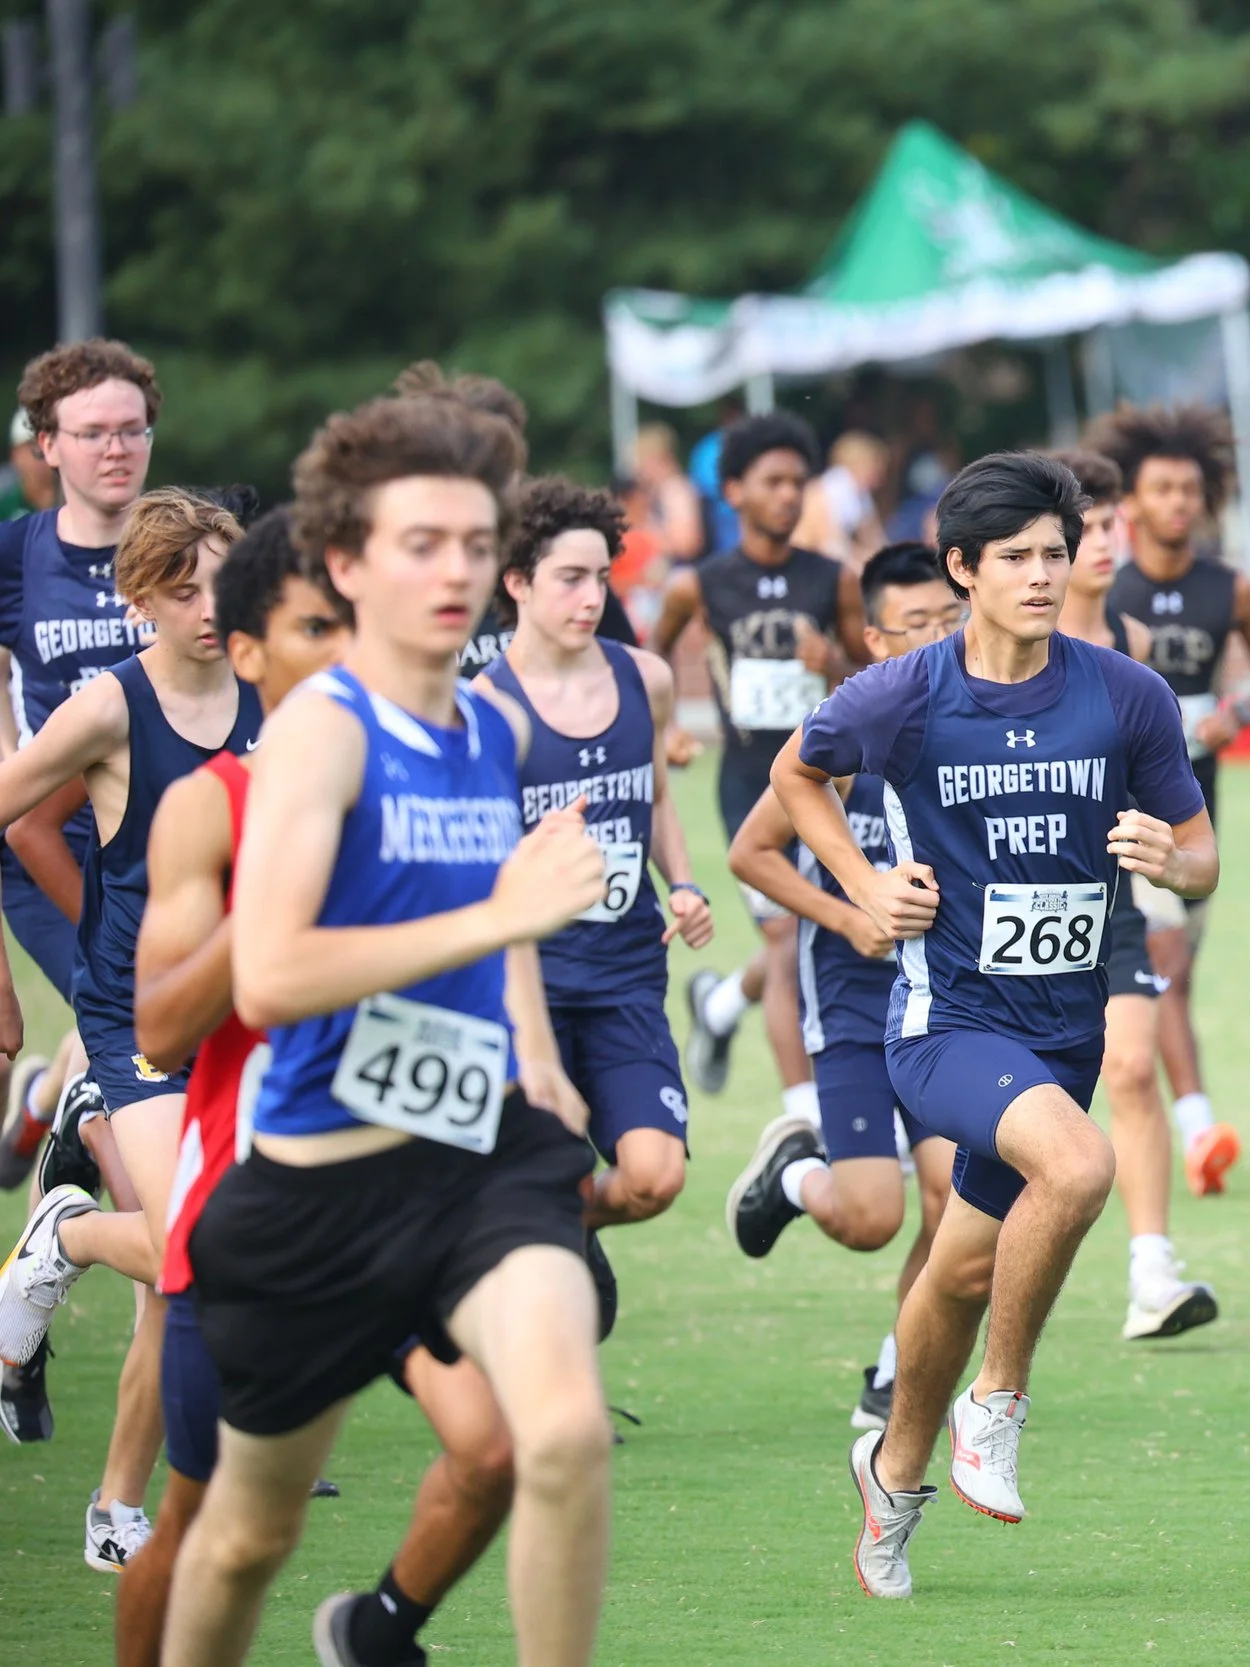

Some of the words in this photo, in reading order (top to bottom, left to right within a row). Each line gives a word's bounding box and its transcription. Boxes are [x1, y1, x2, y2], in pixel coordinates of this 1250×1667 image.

[937, 757, 1107, 808] GEORGETOWN
[984, 813, 1067, 861] PREP
[992, 914, 1094, 965] 268
[357, 1042, 491, 1128] 499
